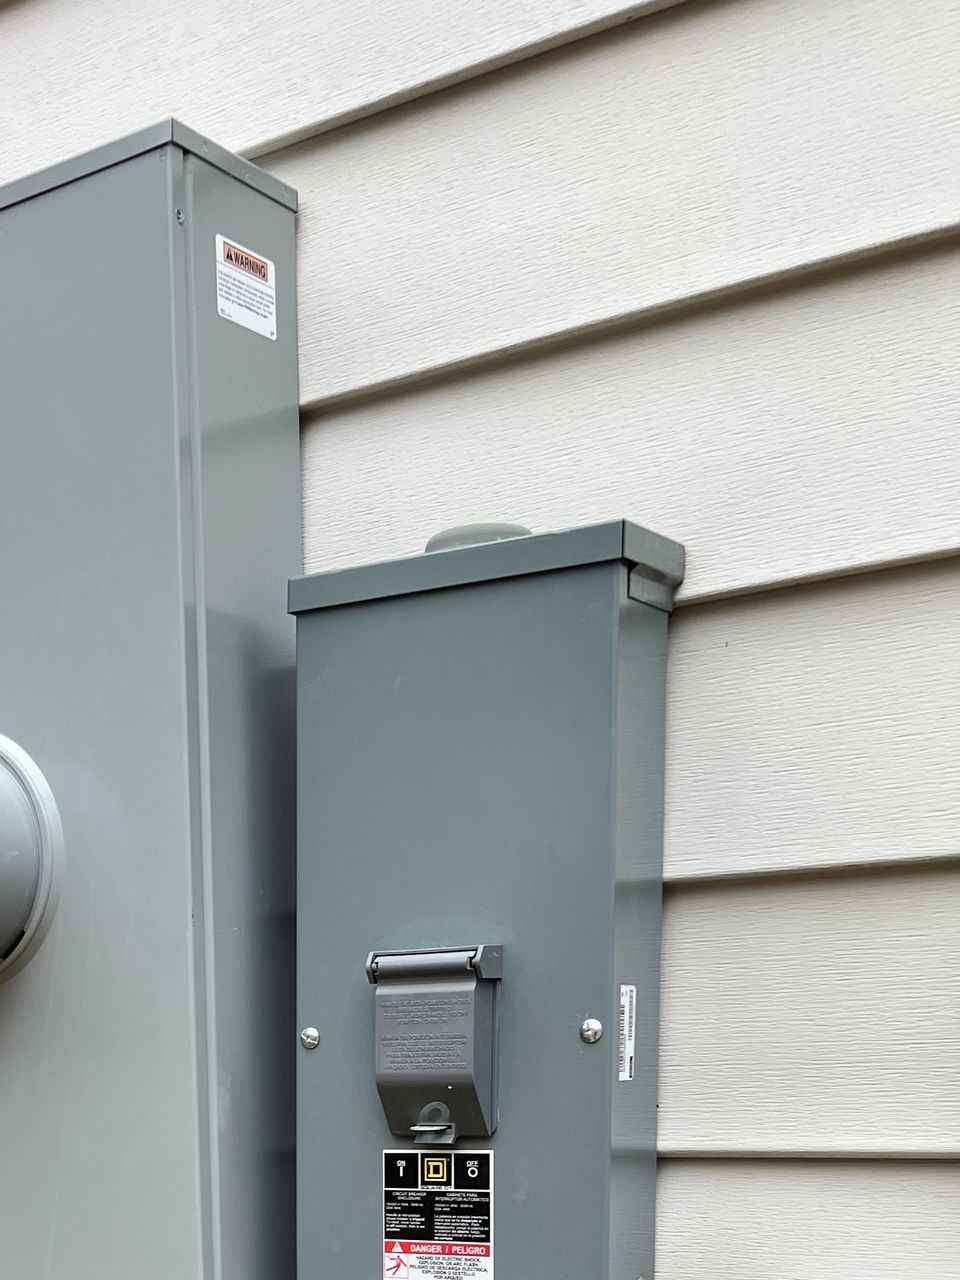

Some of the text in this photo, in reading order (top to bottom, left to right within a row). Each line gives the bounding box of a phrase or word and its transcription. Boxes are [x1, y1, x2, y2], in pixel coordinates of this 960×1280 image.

[234, 251, 266, 278] WARNING
[410, 1244, 442, 1254] DANGER
[451, 1246, 486, 1255] PELIGRO
